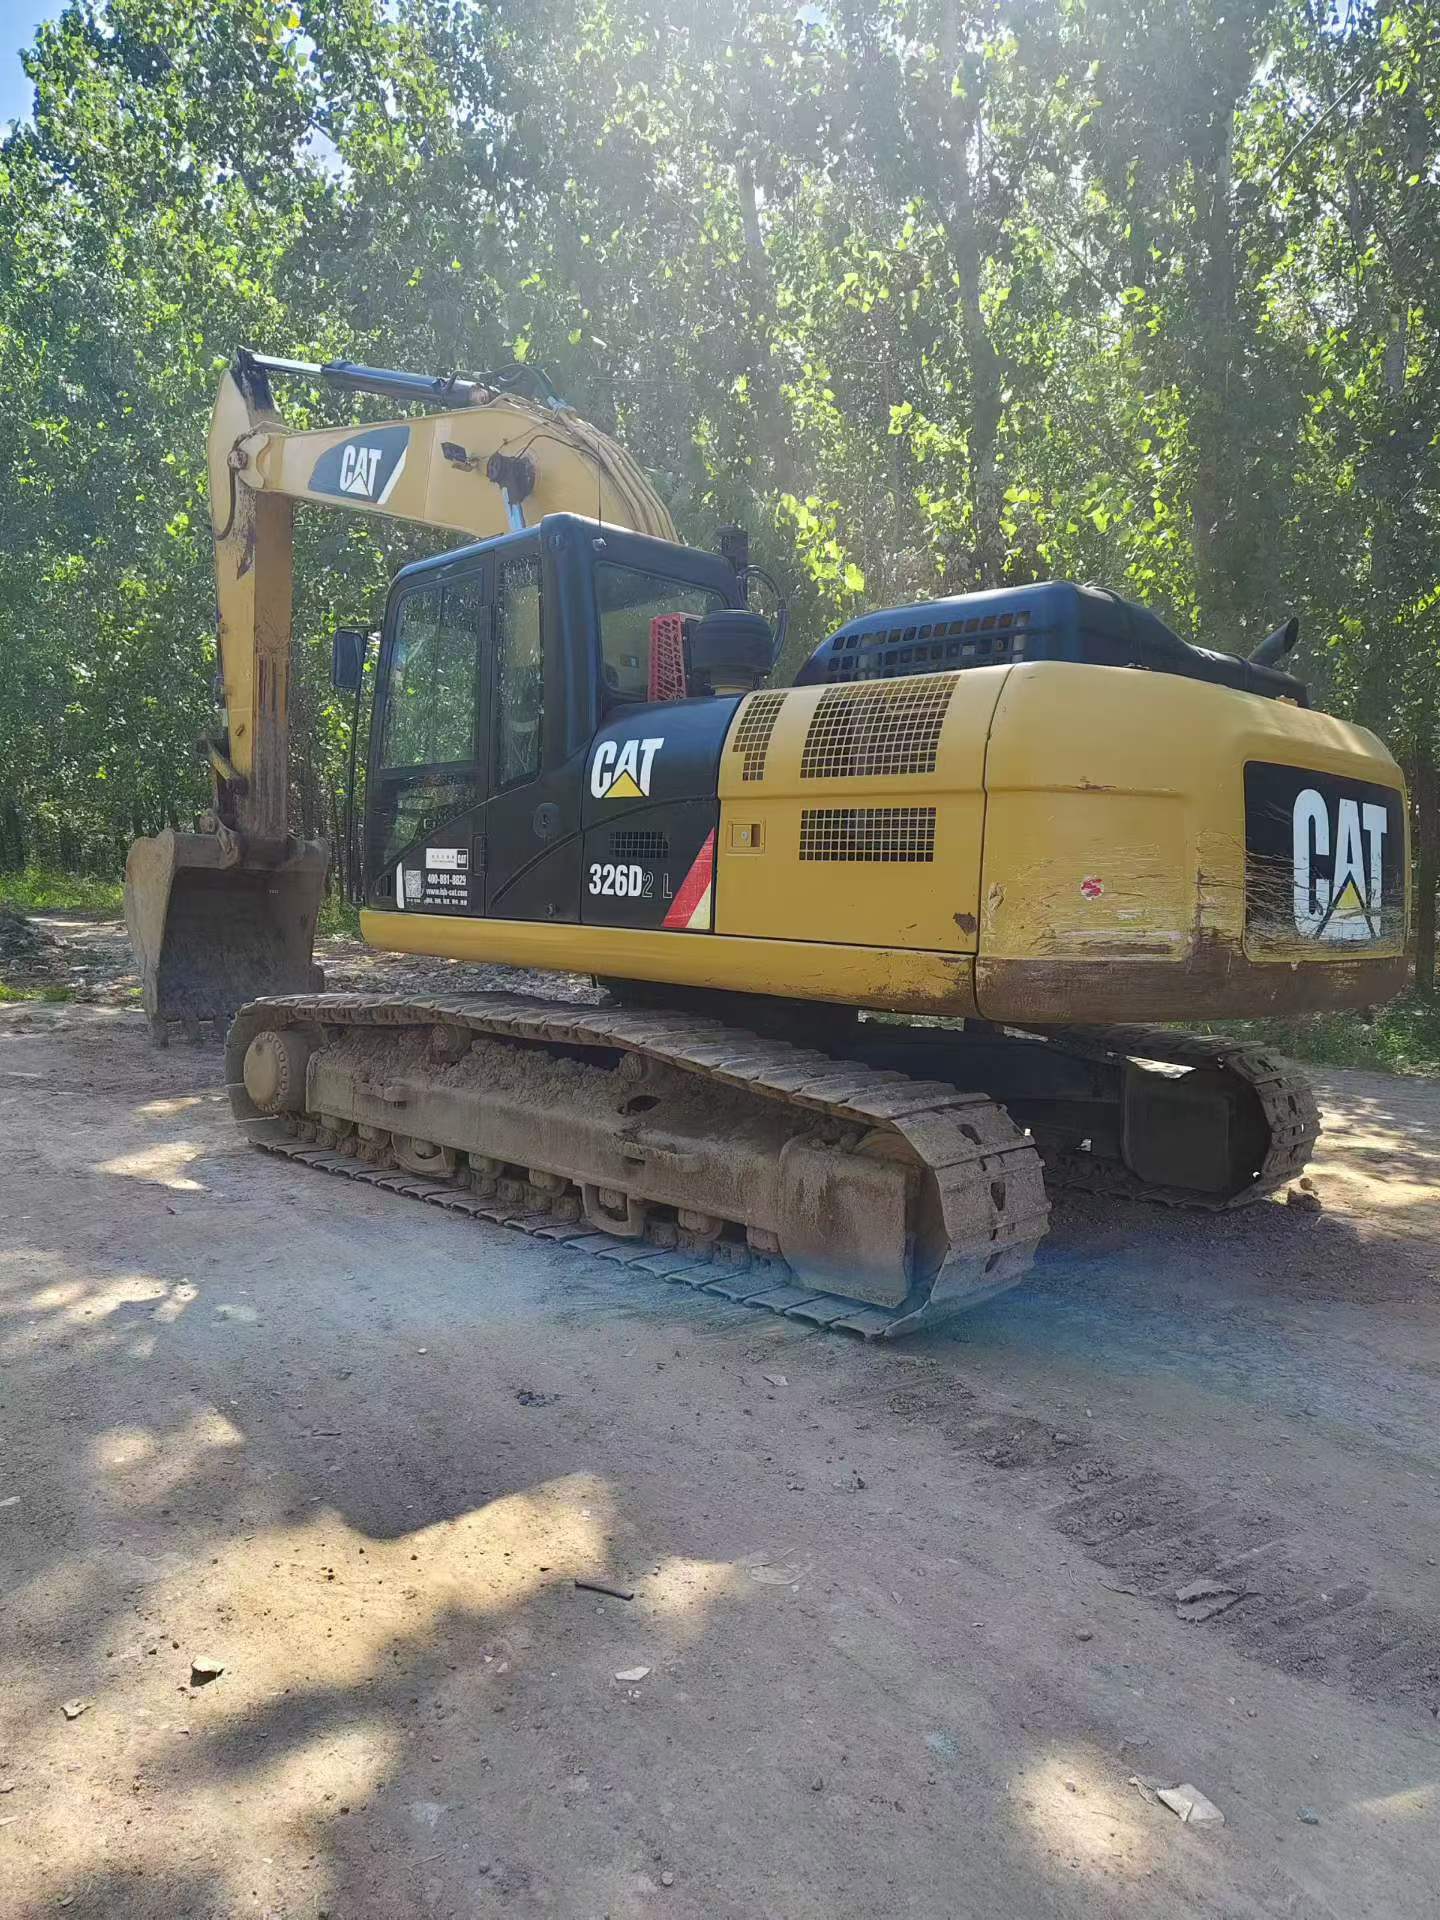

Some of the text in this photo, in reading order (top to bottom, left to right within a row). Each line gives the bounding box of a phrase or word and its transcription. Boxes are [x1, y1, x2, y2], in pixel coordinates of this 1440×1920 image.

[340, 445, 382, 496] CAT
[590, 738, 664, 798] CAT
[1293, 788, 1388, 941] CAT
